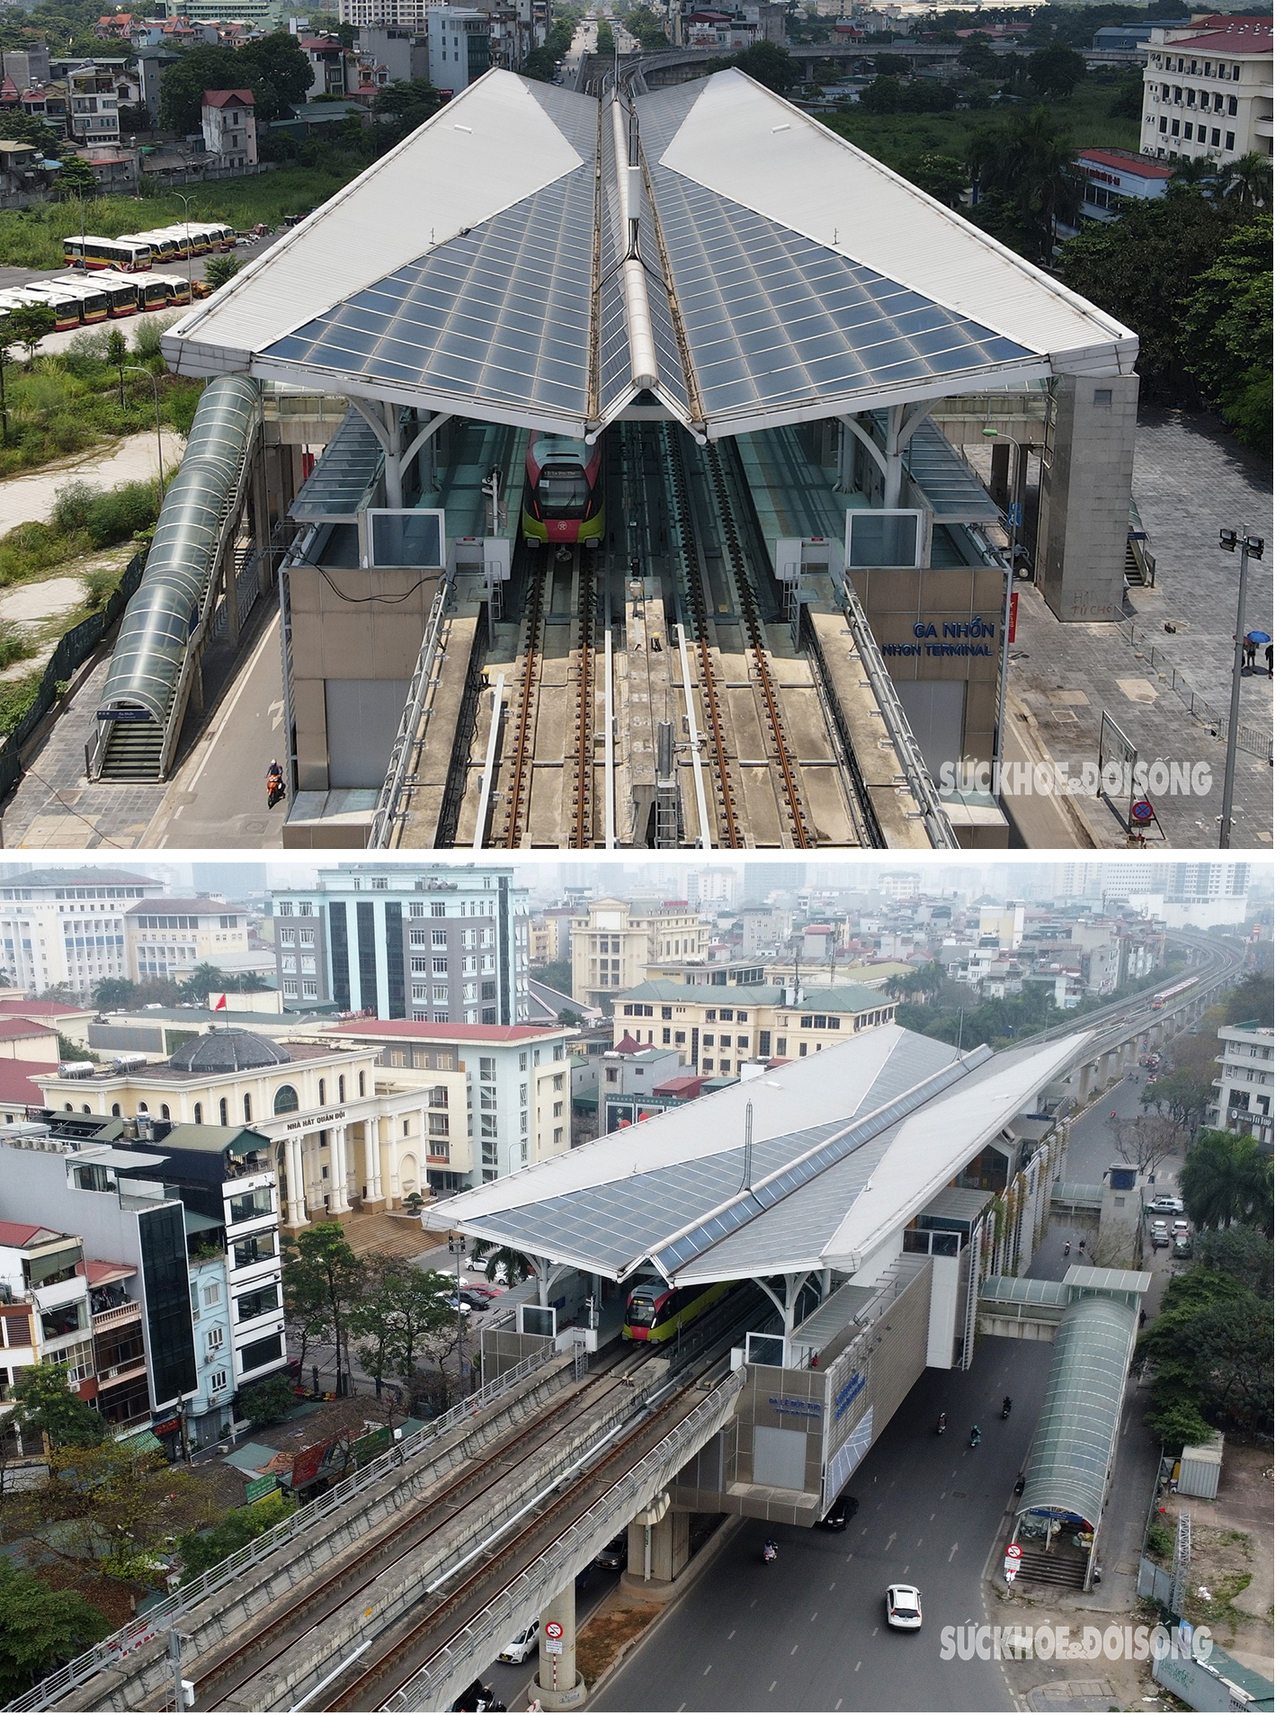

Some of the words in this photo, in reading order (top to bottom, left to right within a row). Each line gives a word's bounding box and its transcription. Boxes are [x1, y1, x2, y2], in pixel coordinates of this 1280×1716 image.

[913, 622, 938, 638] GA
[882, 644, 922, 656] NHON
[925, 644, 993, 657] TERMINAL
[287, 1121, 301, 1131] NHÀ
[302, 1118, 315, 1127] HÁT
[316, 1113, 334, 1124] QUÂN
